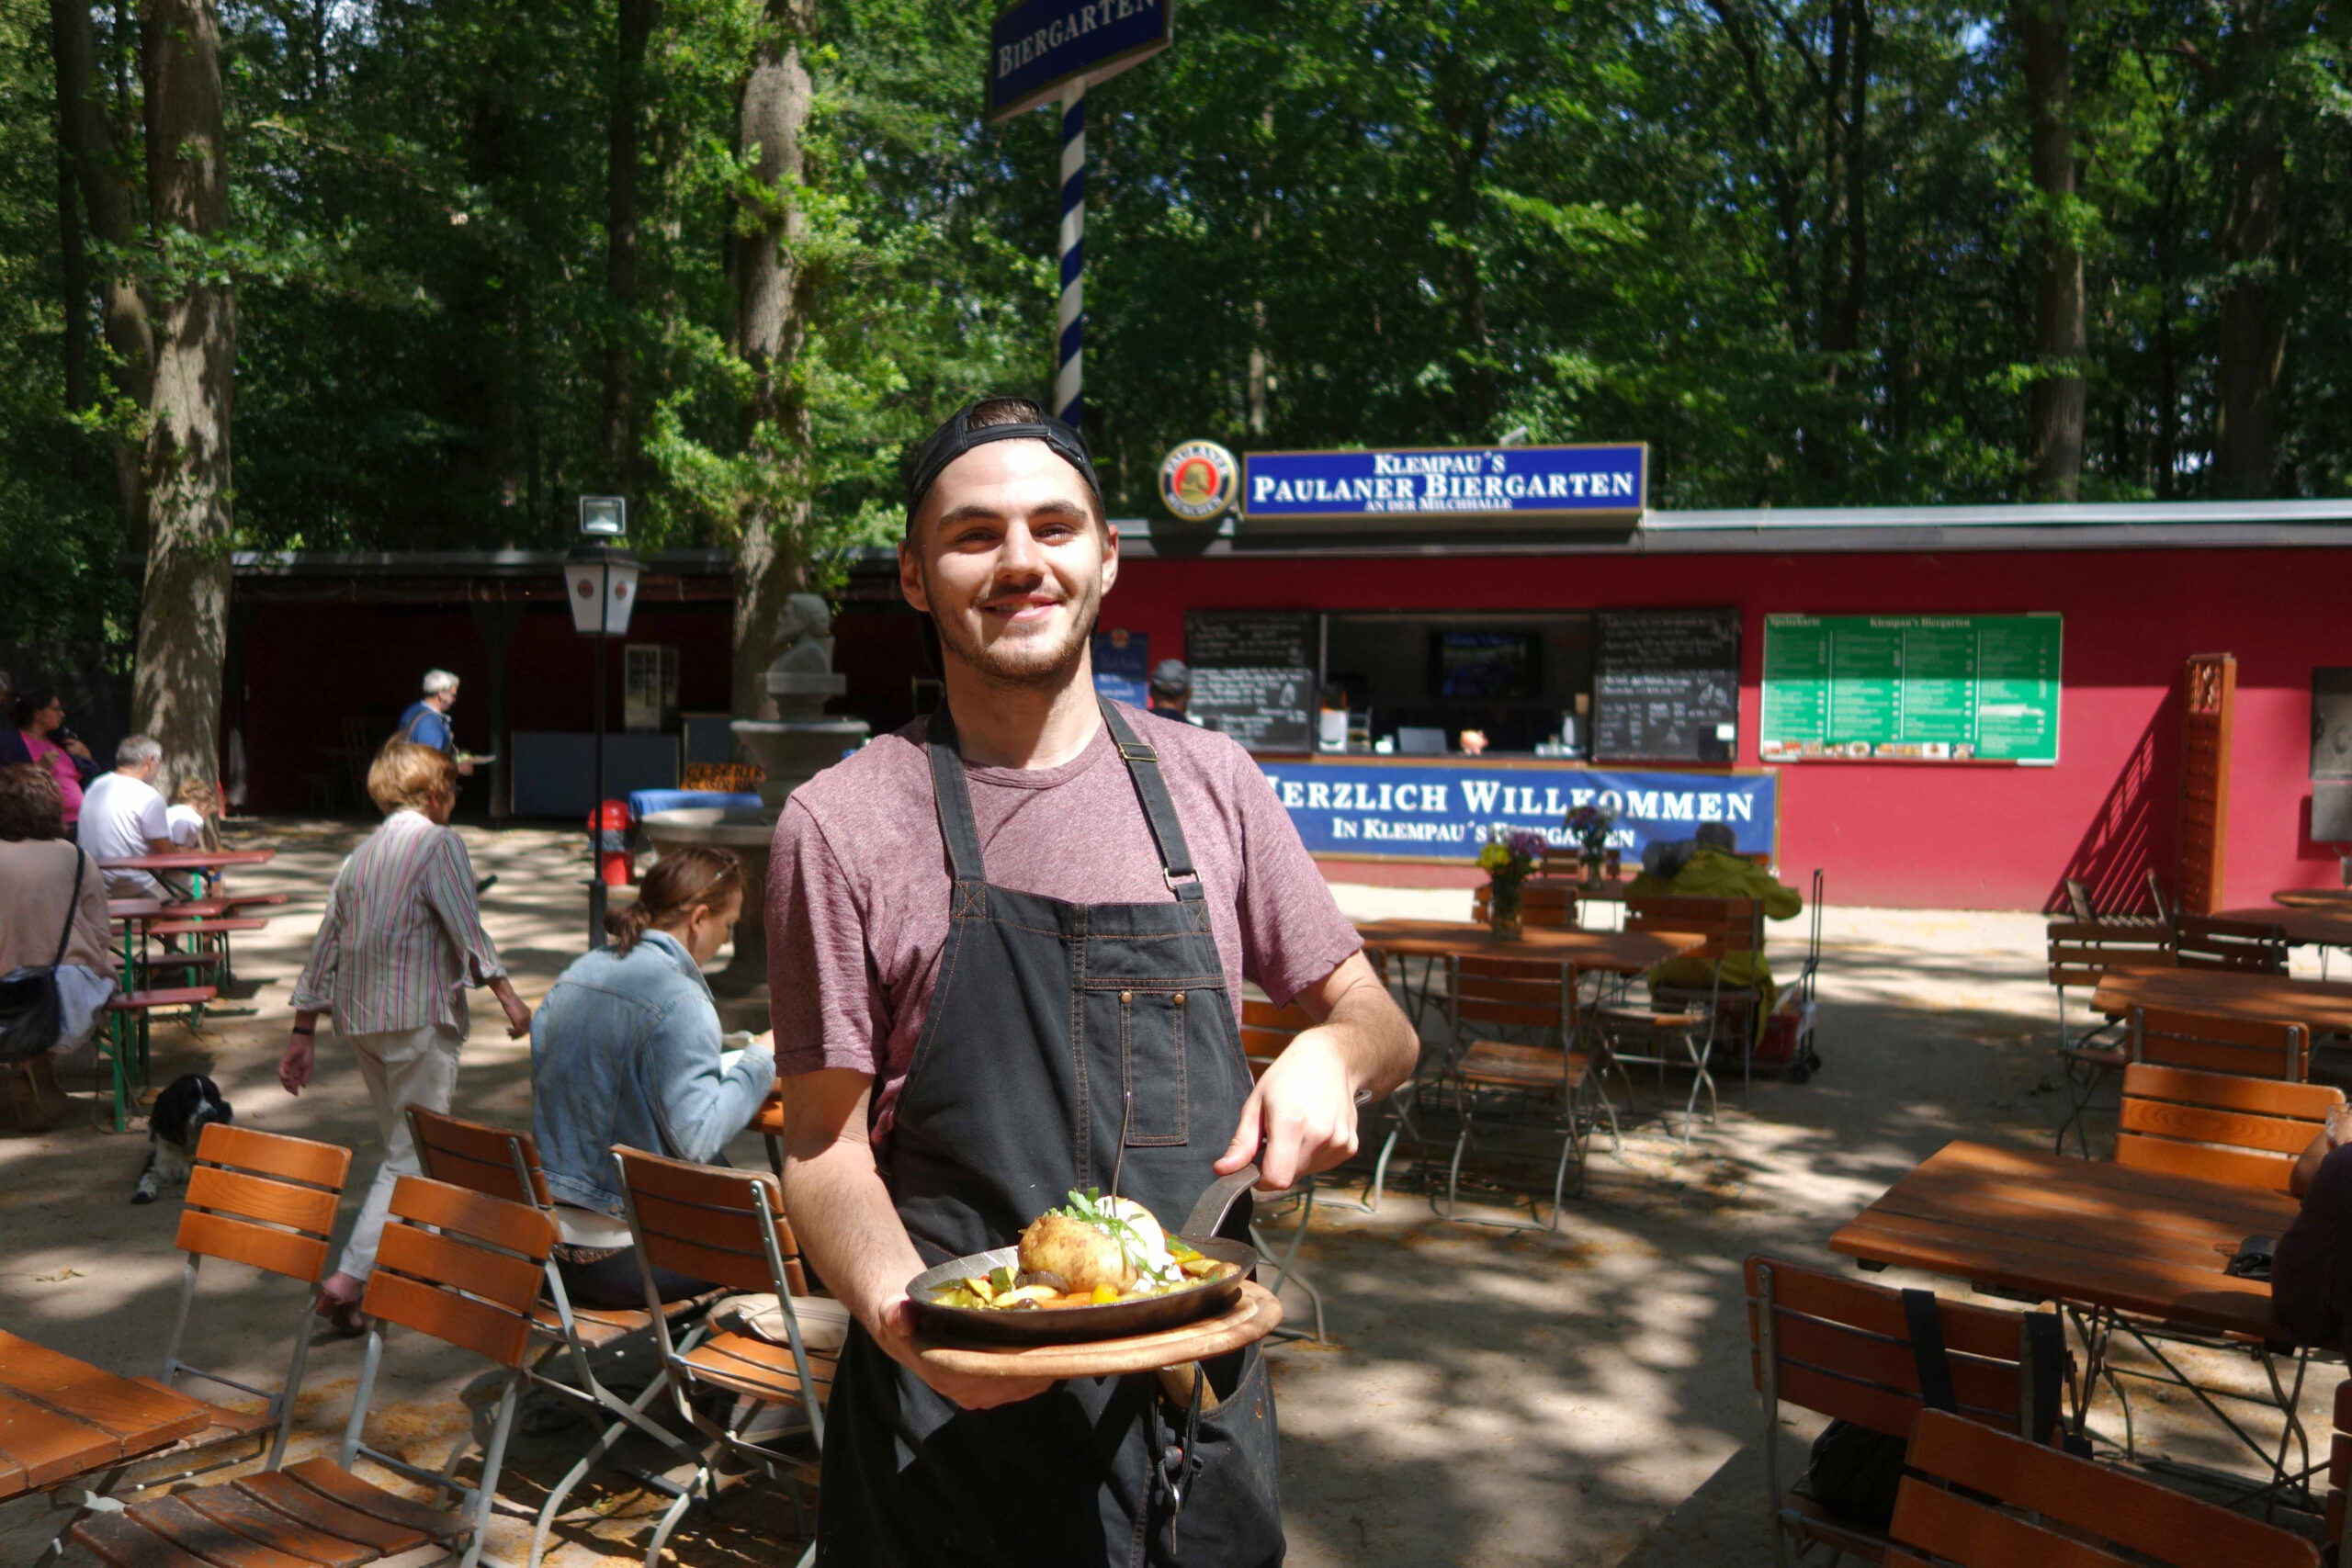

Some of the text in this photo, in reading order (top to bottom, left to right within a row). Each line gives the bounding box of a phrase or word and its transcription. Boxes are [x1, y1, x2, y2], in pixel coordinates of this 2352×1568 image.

[1165, 446, 1229, 474] PAULANER
[1252, 472, 1634, 503] PAULANER BIERGARTEN
[1364, 497, 1512, 512] AN DER MILCHHALLE
[1461, 780, 1753, 821] WILLKOMMEN
[1332, 817, 1358, 840] IN
[1490, 821, 1635, 849] BRGAEN
